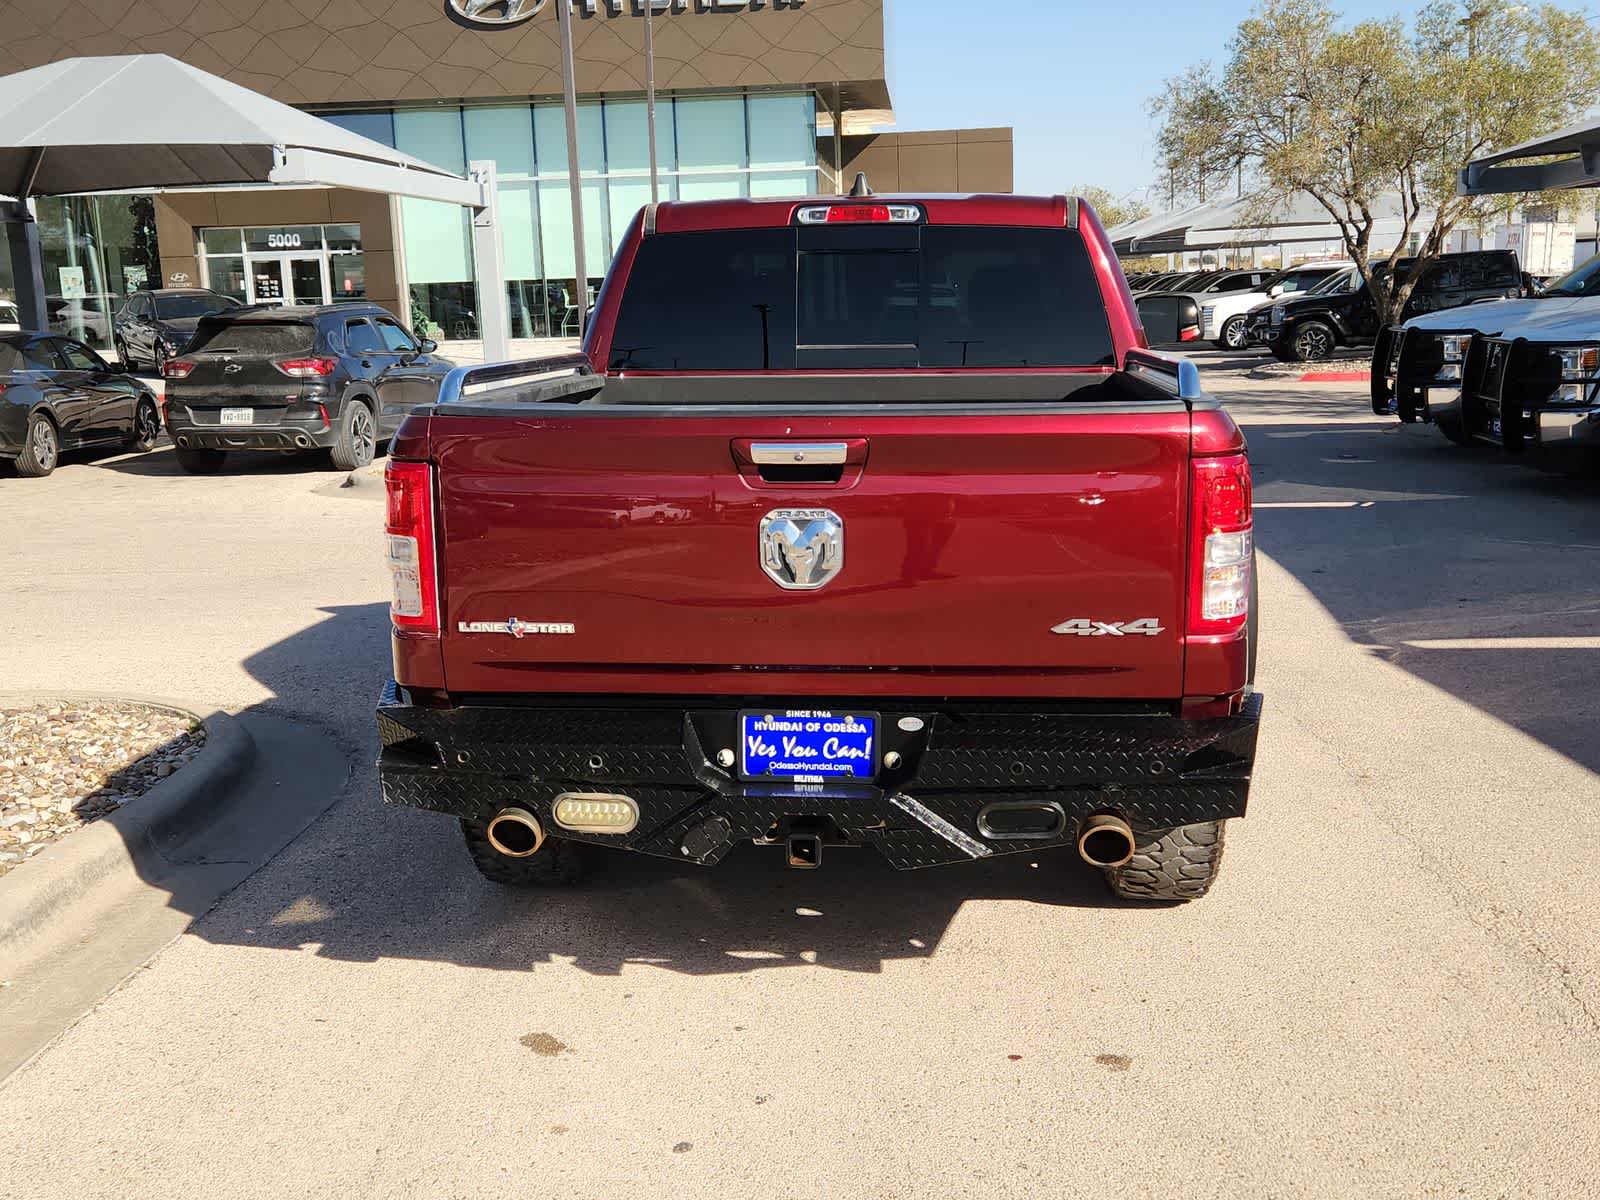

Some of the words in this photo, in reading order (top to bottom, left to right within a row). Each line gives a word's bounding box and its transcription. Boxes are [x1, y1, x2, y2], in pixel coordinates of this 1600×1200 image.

[268, 233, 301, 248] 5000
[776, 510, 828, 519] RAM
[458, 621, 508, 633] LONE
[525, 622, 576, 634] STAR
[1050, 617, 1166, 636] 4x4
[786, 710, 811, 718] SINCE
[812, 710, 832, 718] 1946
[754, 721, 802, 732] HYUNDAI
[805, 722, 820, 733] OF
[823, 722, 867, 734] ODESSA
[748, 735, 777, 758] Yes
[781, 736, 819, 759] You
[822, 736, 873, 760] Can!
